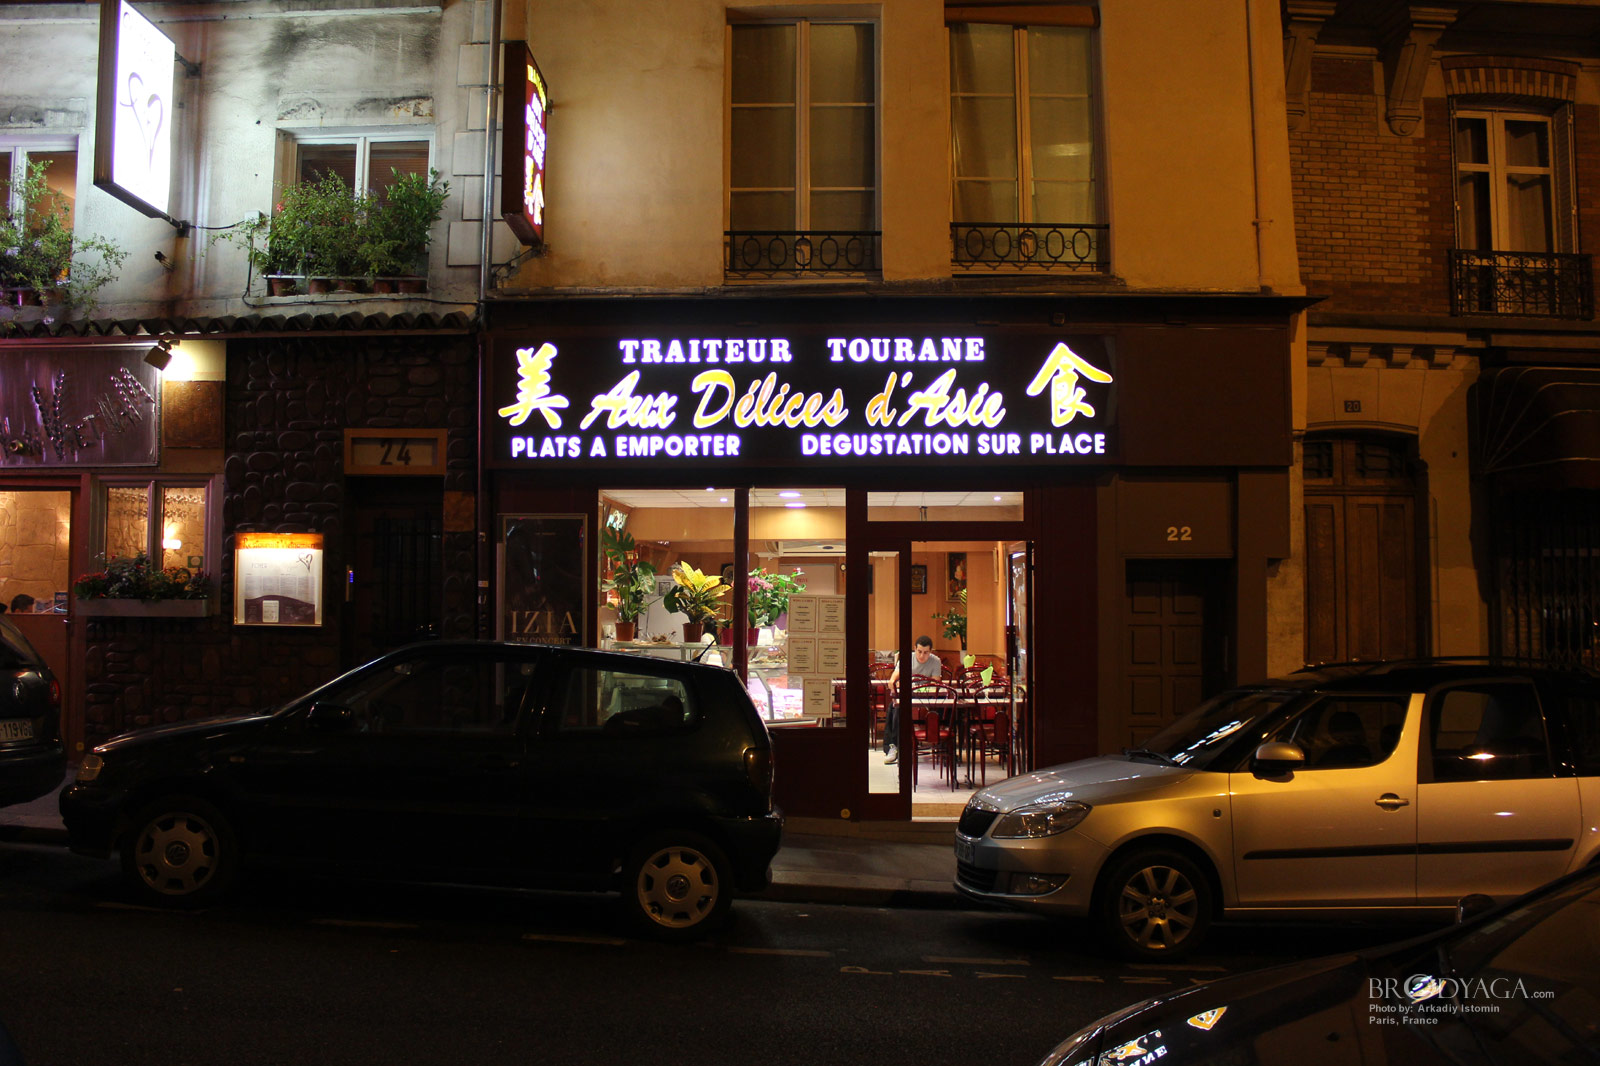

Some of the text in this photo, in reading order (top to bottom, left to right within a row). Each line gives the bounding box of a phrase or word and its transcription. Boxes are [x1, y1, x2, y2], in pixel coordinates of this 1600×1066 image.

[619, 337, 985, 364] TRAITEUR TOURANE
[498, 342, 569, 430] 美
[1026, 342, 1114, 428] 食
[580, 367, 1007, 430] Aux Délices d'Asie
[1345, 401, 1361, 412] 20
[380, 439, 411, 466] 24
[511, 434, 741, 458] PLATS A EMPORTER
[801, 433, 1105, 456] DEGUSTATION SUR PLACE
[1167, 526, 1192, 541] 22
[510, 610, 578, 634] IZIA
